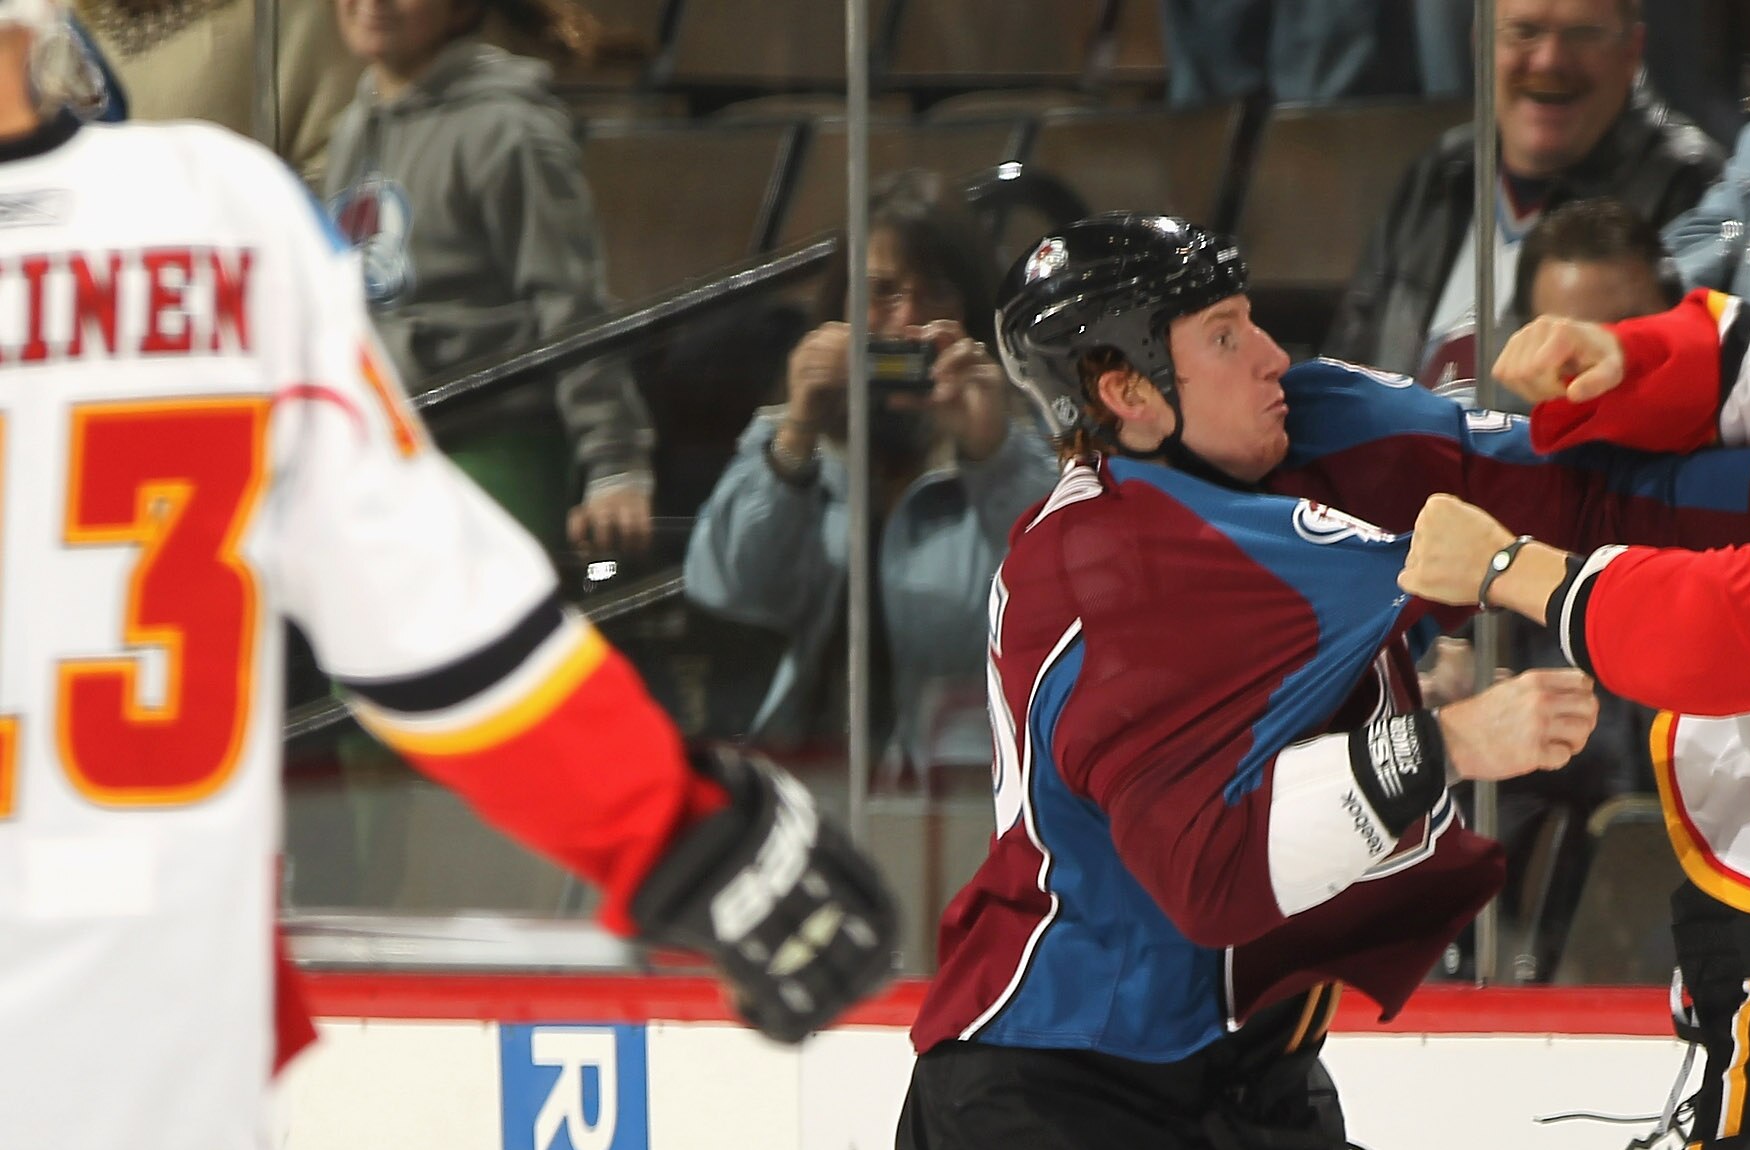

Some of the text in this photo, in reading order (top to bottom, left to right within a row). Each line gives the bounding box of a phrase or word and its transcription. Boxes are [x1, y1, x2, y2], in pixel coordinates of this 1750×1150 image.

[0, 244, 254, 363] INEN
[0, 392, 275, 814] 3
[1341, 787, 1386, 857] Reebok
